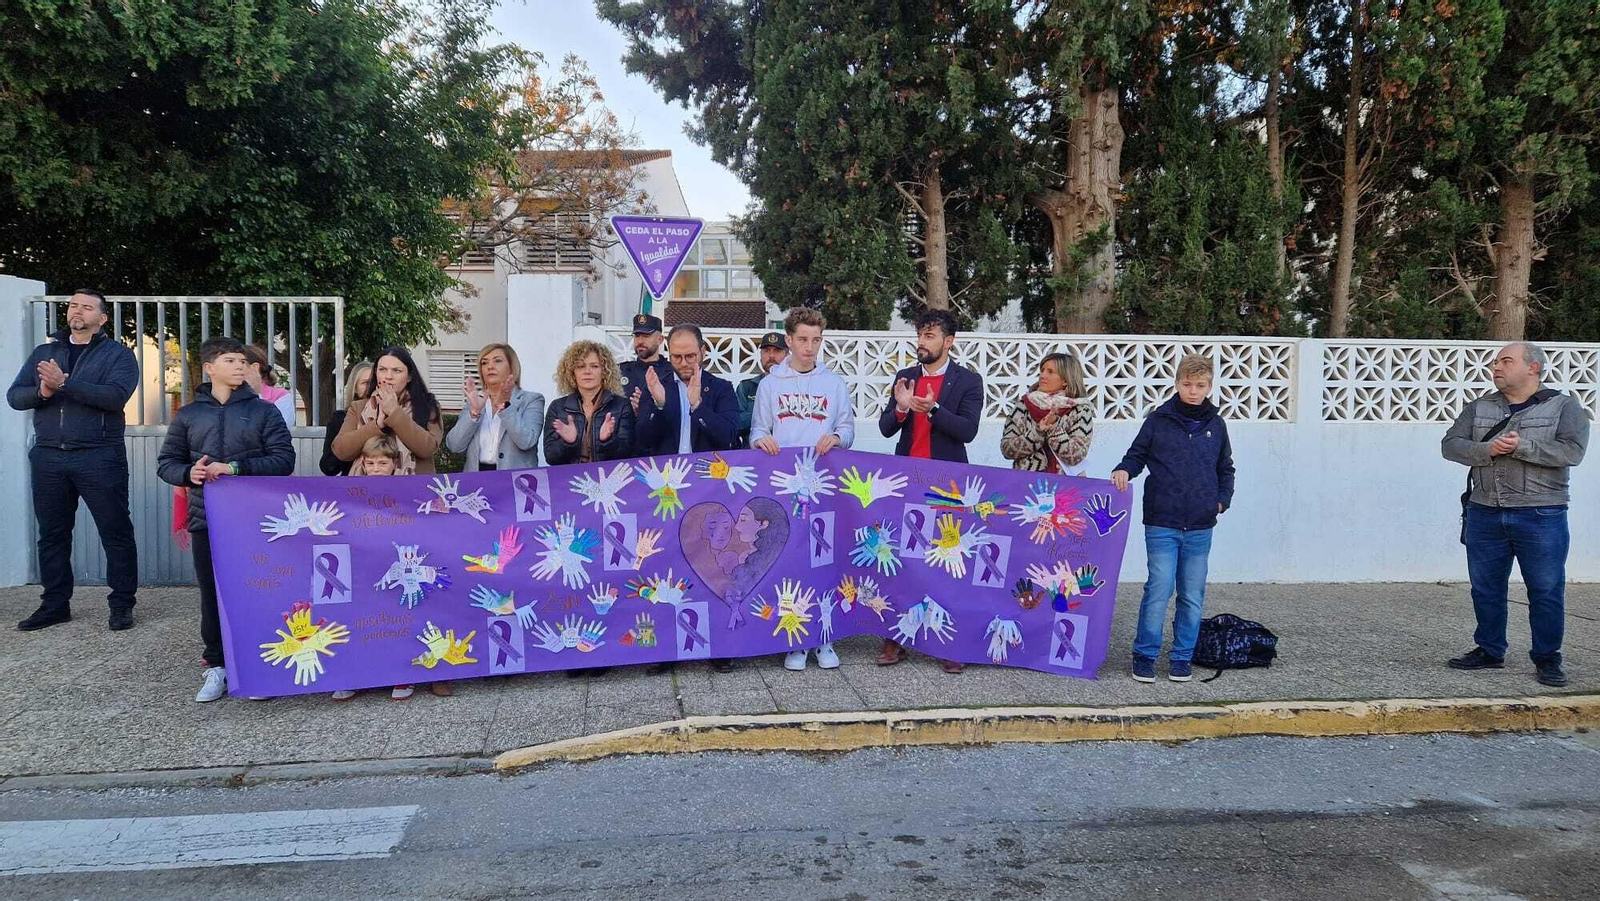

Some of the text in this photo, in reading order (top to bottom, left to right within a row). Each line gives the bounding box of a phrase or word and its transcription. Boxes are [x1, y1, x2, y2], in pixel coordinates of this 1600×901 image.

[625, 226, 690, 236] CEDA EL PASO
[648, 236, 668, 245] A LA
[640, 243, 680, 262] Igualdad
